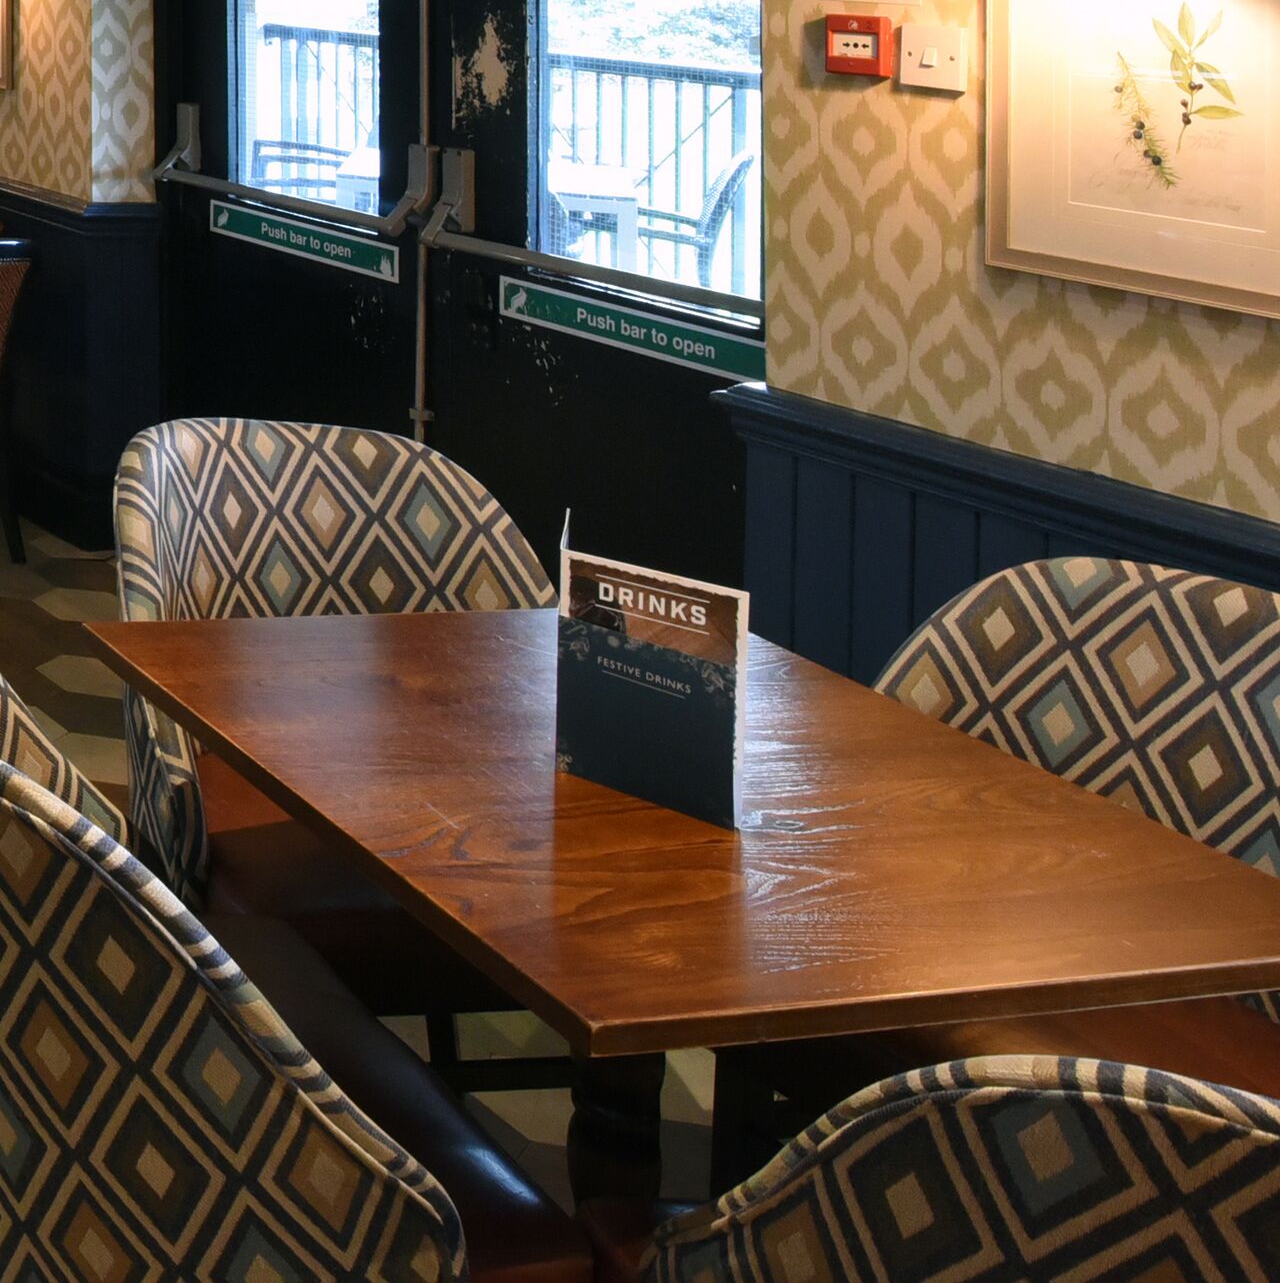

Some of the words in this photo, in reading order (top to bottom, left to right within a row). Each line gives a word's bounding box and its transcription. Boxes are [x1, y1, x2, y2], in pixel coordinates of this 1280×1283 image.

[261, 222, 287, 241] Push
[289, 230, 307, 246] bar
[310, 236, 321, 250] to
[323, 241, 351, 258] open
[576, 307, 616, 332] Push
[620, 319, 647, 340] bar
[651, 328, 668, 346] to
[672, 337, 716, 359] open
[599, 581, 707, 626] DRINKS
[597, 656, 641, 678] FESTIVE
[645, 672, 692, 694] DRINKS
